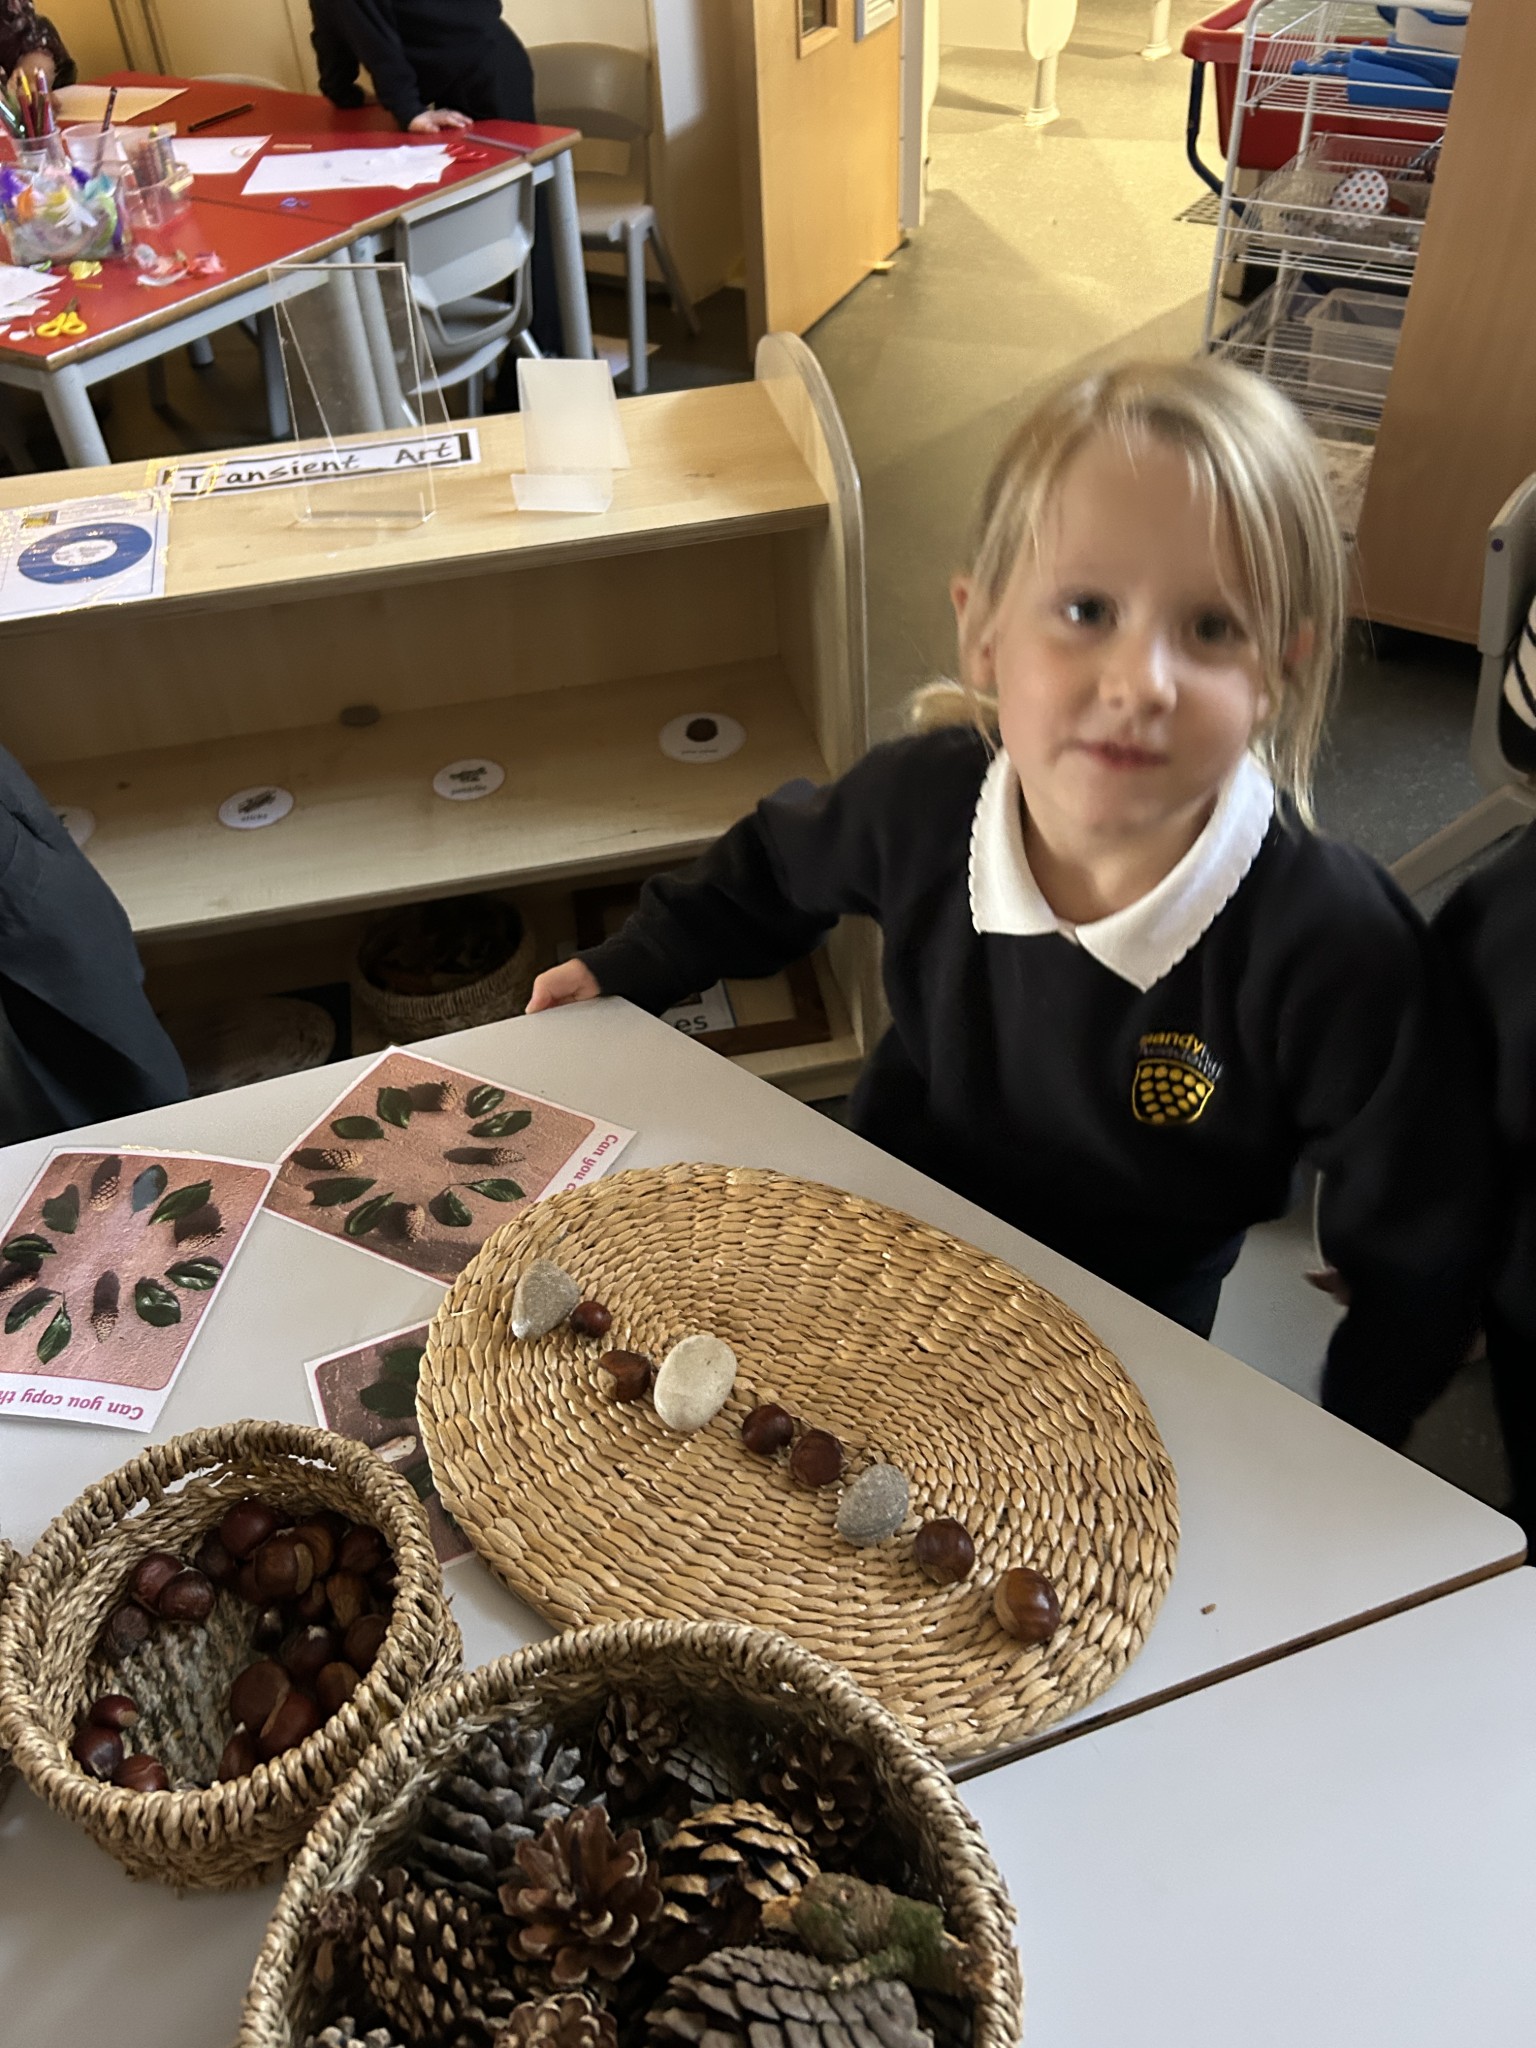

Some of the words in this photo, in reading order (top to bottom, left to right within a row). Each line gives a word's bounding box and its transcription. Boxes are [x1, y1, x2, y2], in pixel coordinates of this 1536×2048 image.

[394, 441, 453, 465] Art
[592, 1134, 619, 1156] Can
[573, 1156, 597, 1180] you
[20, 1388, 63, 1406] copy
[67, 1395, 104, 1411] you
[107, 1402, 145, 1421] Can
